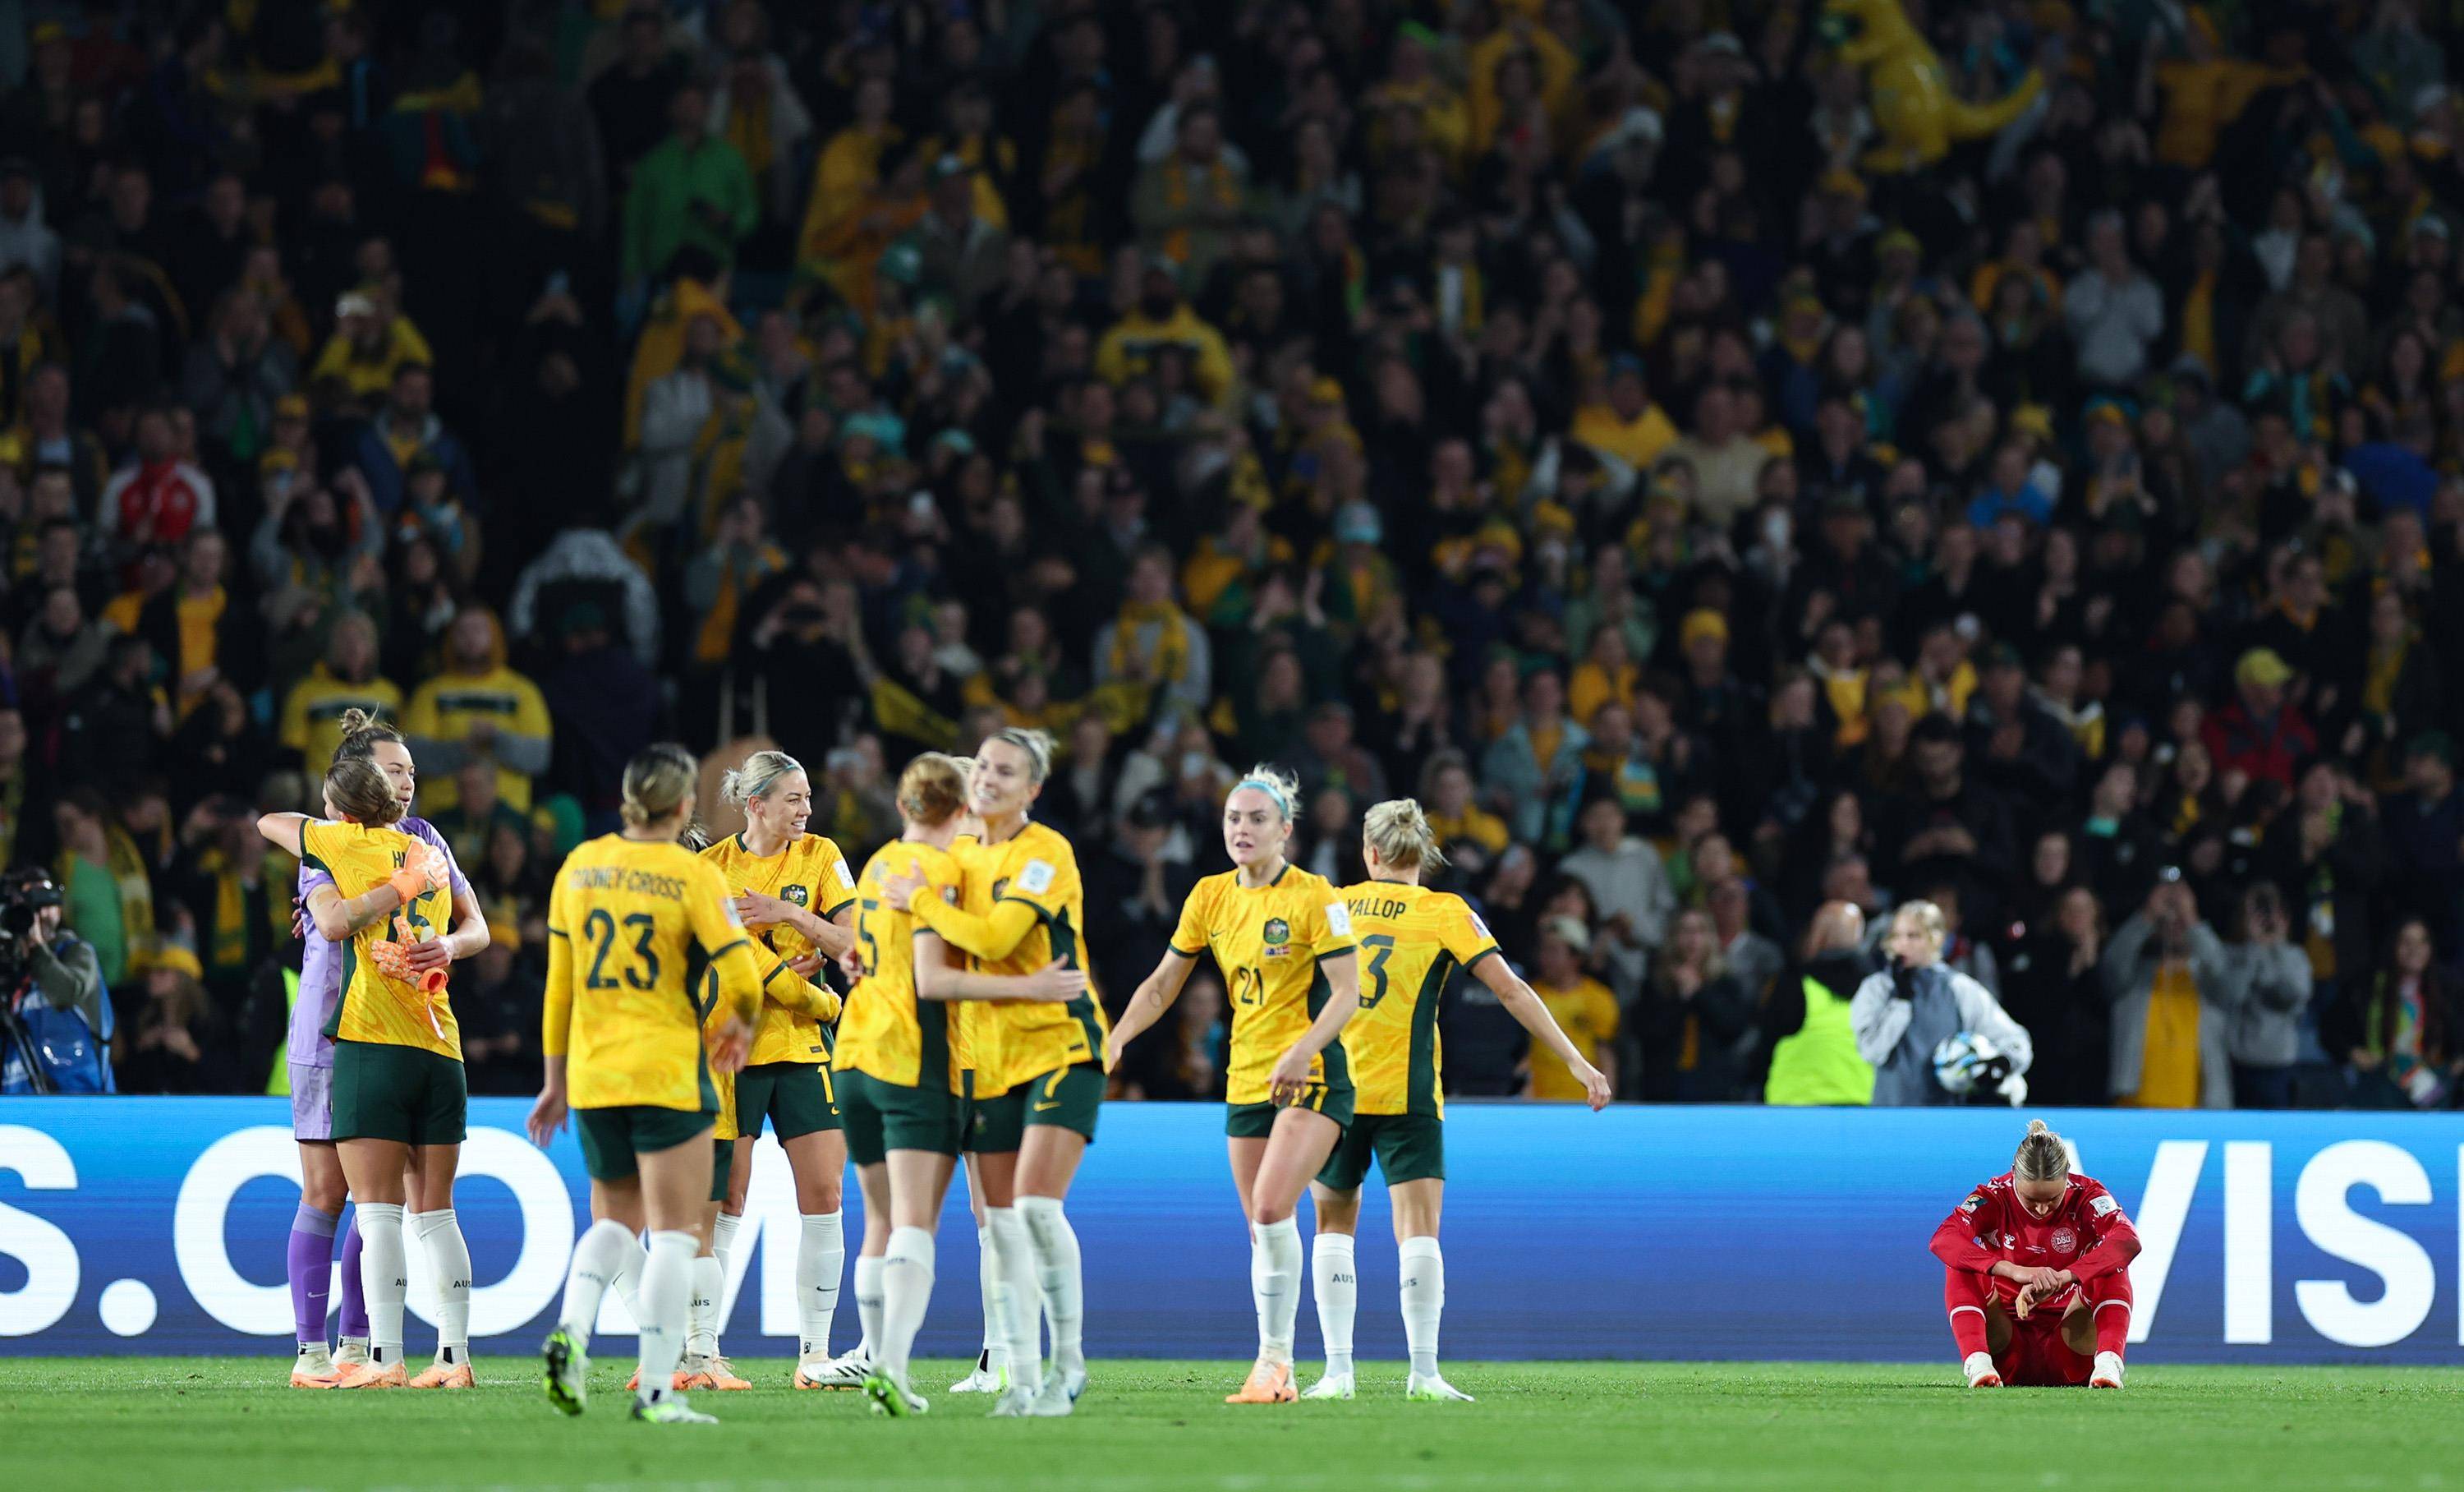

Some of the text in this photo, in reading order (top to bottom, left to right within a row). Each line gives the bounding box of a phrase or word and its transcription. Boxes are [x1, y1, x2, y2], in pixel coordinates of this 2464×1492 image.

[1348, 897, 1406, 920] YALLOP
[584, 909, 659, 989] 23
[1239, 965, 1263, 1006] 21
[2060, 1140, 2464, 1347] VIS
